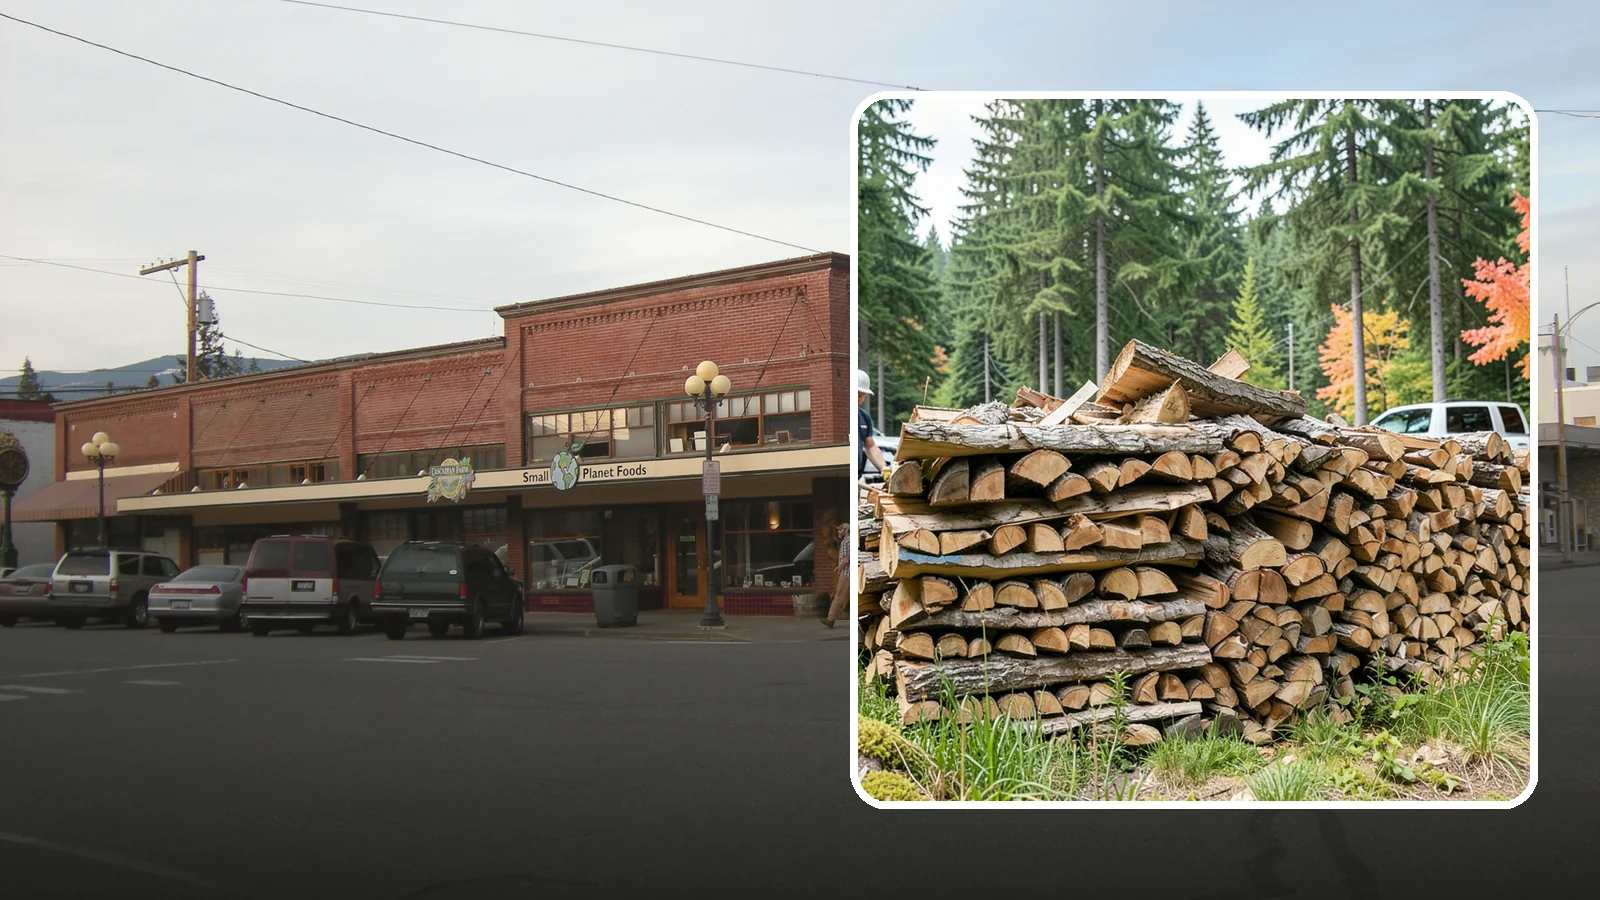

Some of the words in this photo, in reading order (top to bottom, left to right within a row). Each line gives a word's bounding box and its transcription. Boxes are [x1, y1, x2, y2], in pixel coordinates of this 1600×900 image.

[456, 466, 469, 474] FARM
[523, 471, 548, 482] Small
[583, 467, 614, 479] Planet
[617, 464, 647, 476] Foods
